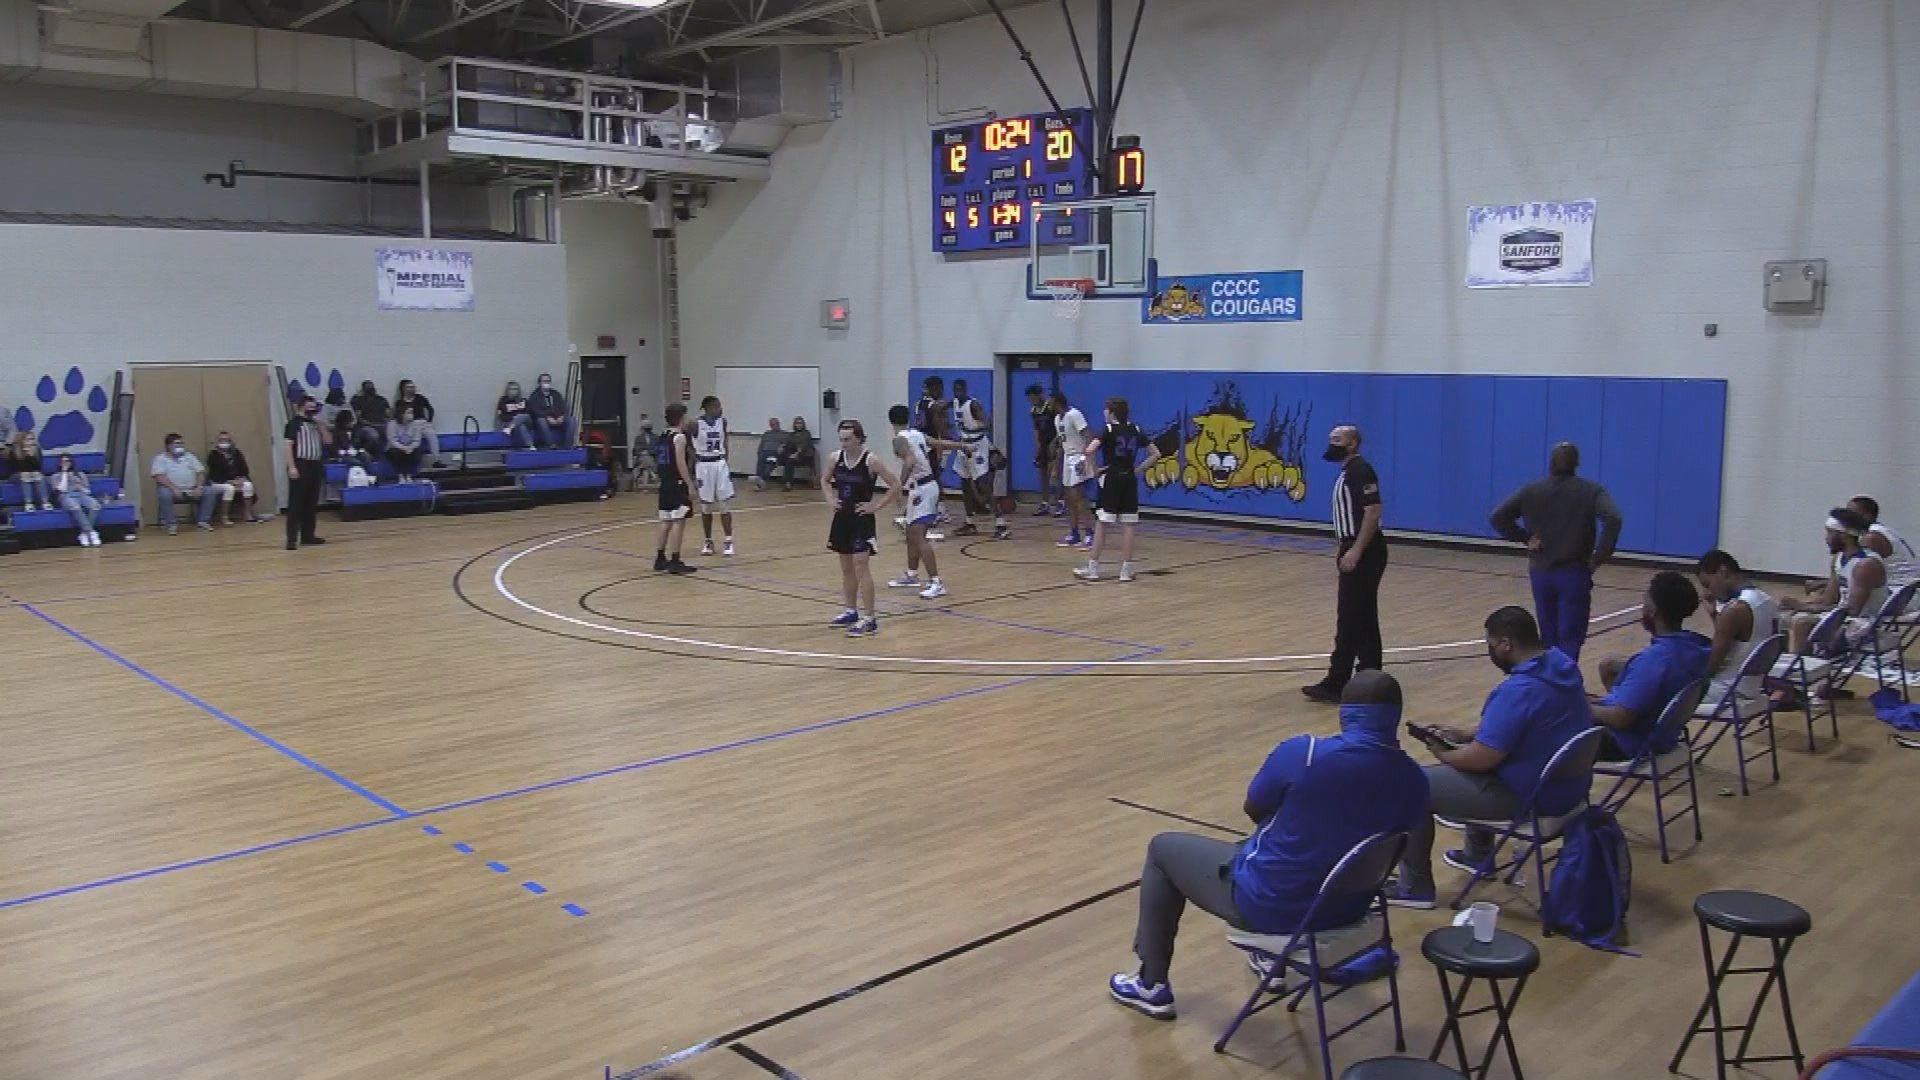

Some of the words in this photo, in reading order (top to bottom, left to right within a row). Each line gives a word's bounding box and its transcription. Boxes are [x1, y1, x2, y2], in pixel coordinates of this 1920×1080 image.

[985, 119, 1030, 151] 10:24
[1047, 130, 1072, 161] 20
[950, 145, 967, 173] 12
[1026, 159, 1031, 178] 1
[1119, 151, 1142, 186] 17
[945, 211, 955, 229] 4
[968, 207, 979, 228] 5
[1502, 245, 1560, 257] SANFORD
[1211, 279, 1260, 297] CCCC
[1211, 298, 1296, 316] COUGARS
